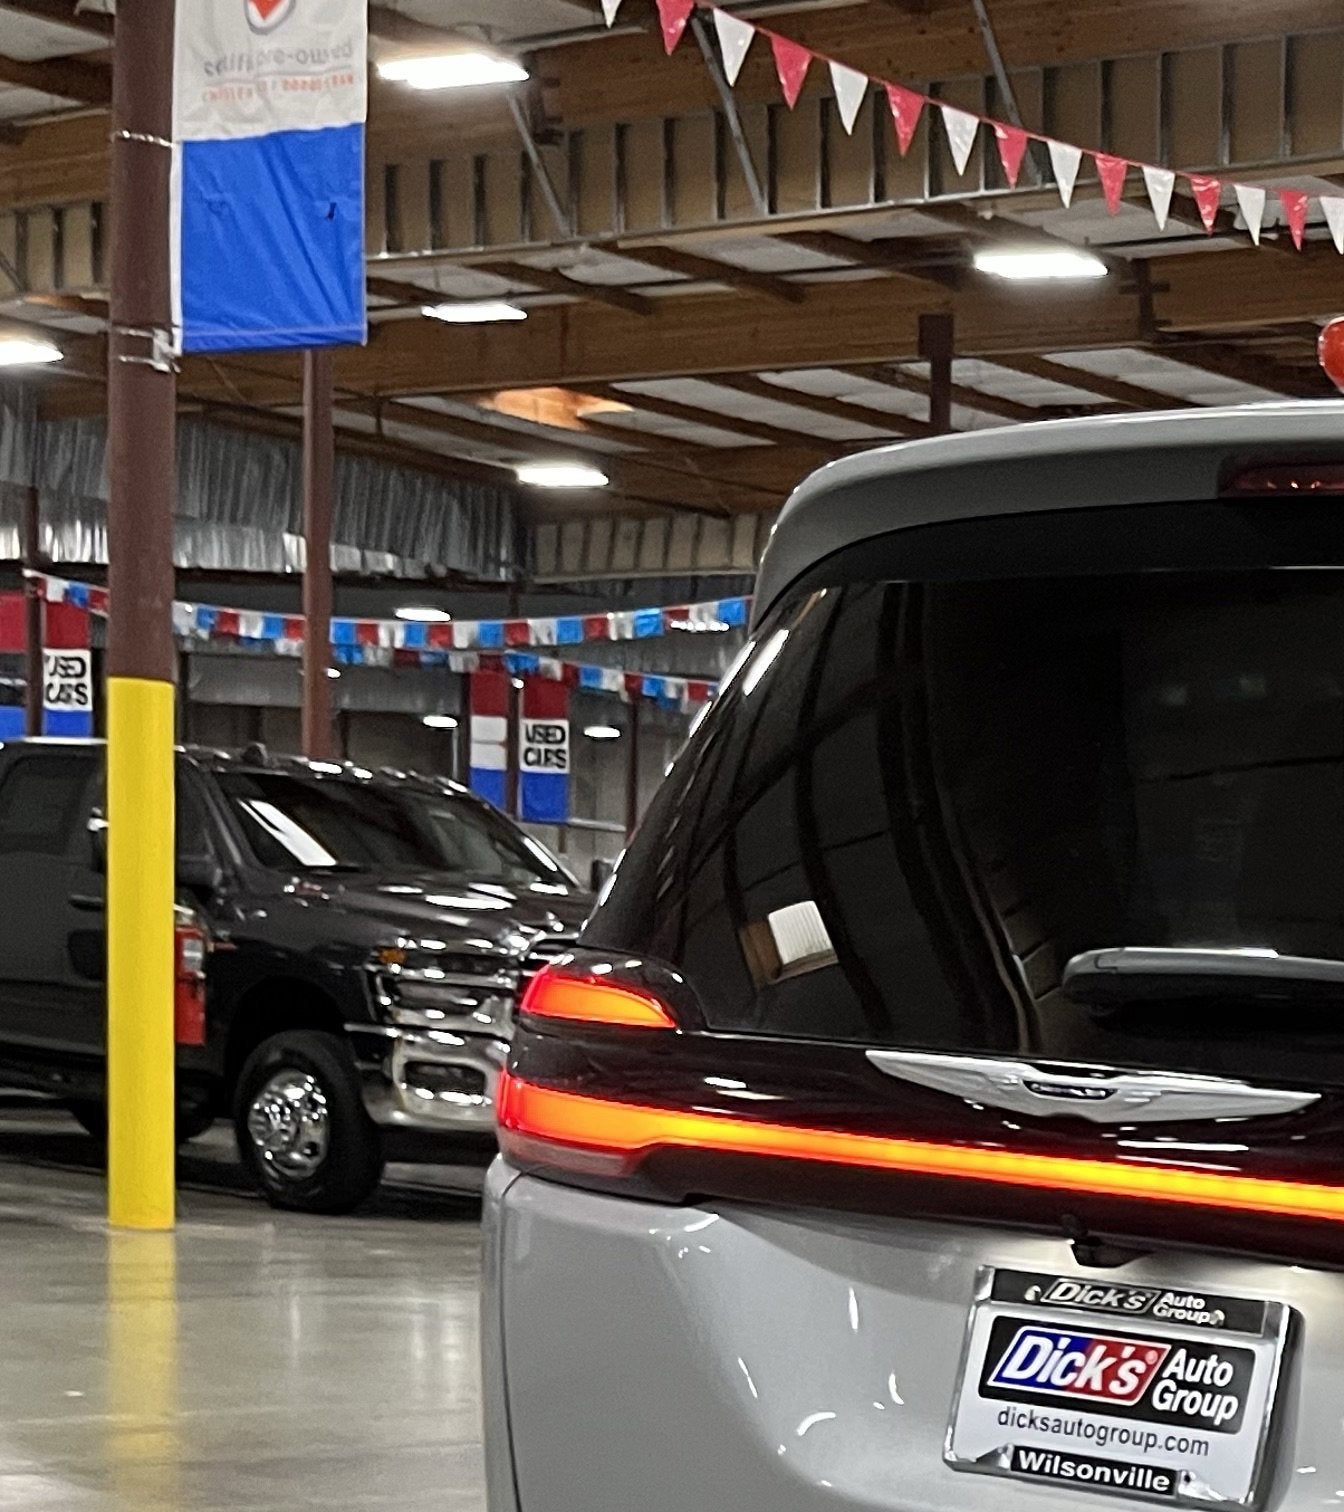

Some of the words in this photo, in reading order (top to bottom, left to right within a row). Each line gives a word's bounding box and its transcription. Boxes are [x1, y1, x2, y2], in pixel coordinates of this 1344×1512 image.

[1153, 1303, 1211, 1324] Group
[1162, 1292, 1206, 1309] Auto
[1001, 1335, 1148, 1395] Dick's
[1162, 1348, 1234, 1387] Auto
[1152, 1379, 1239, 1426] Group
[997, 1405, 1210, 1456] dicksautogroup.com
[1018, 1450, 1170, 1492] Wilsonville
